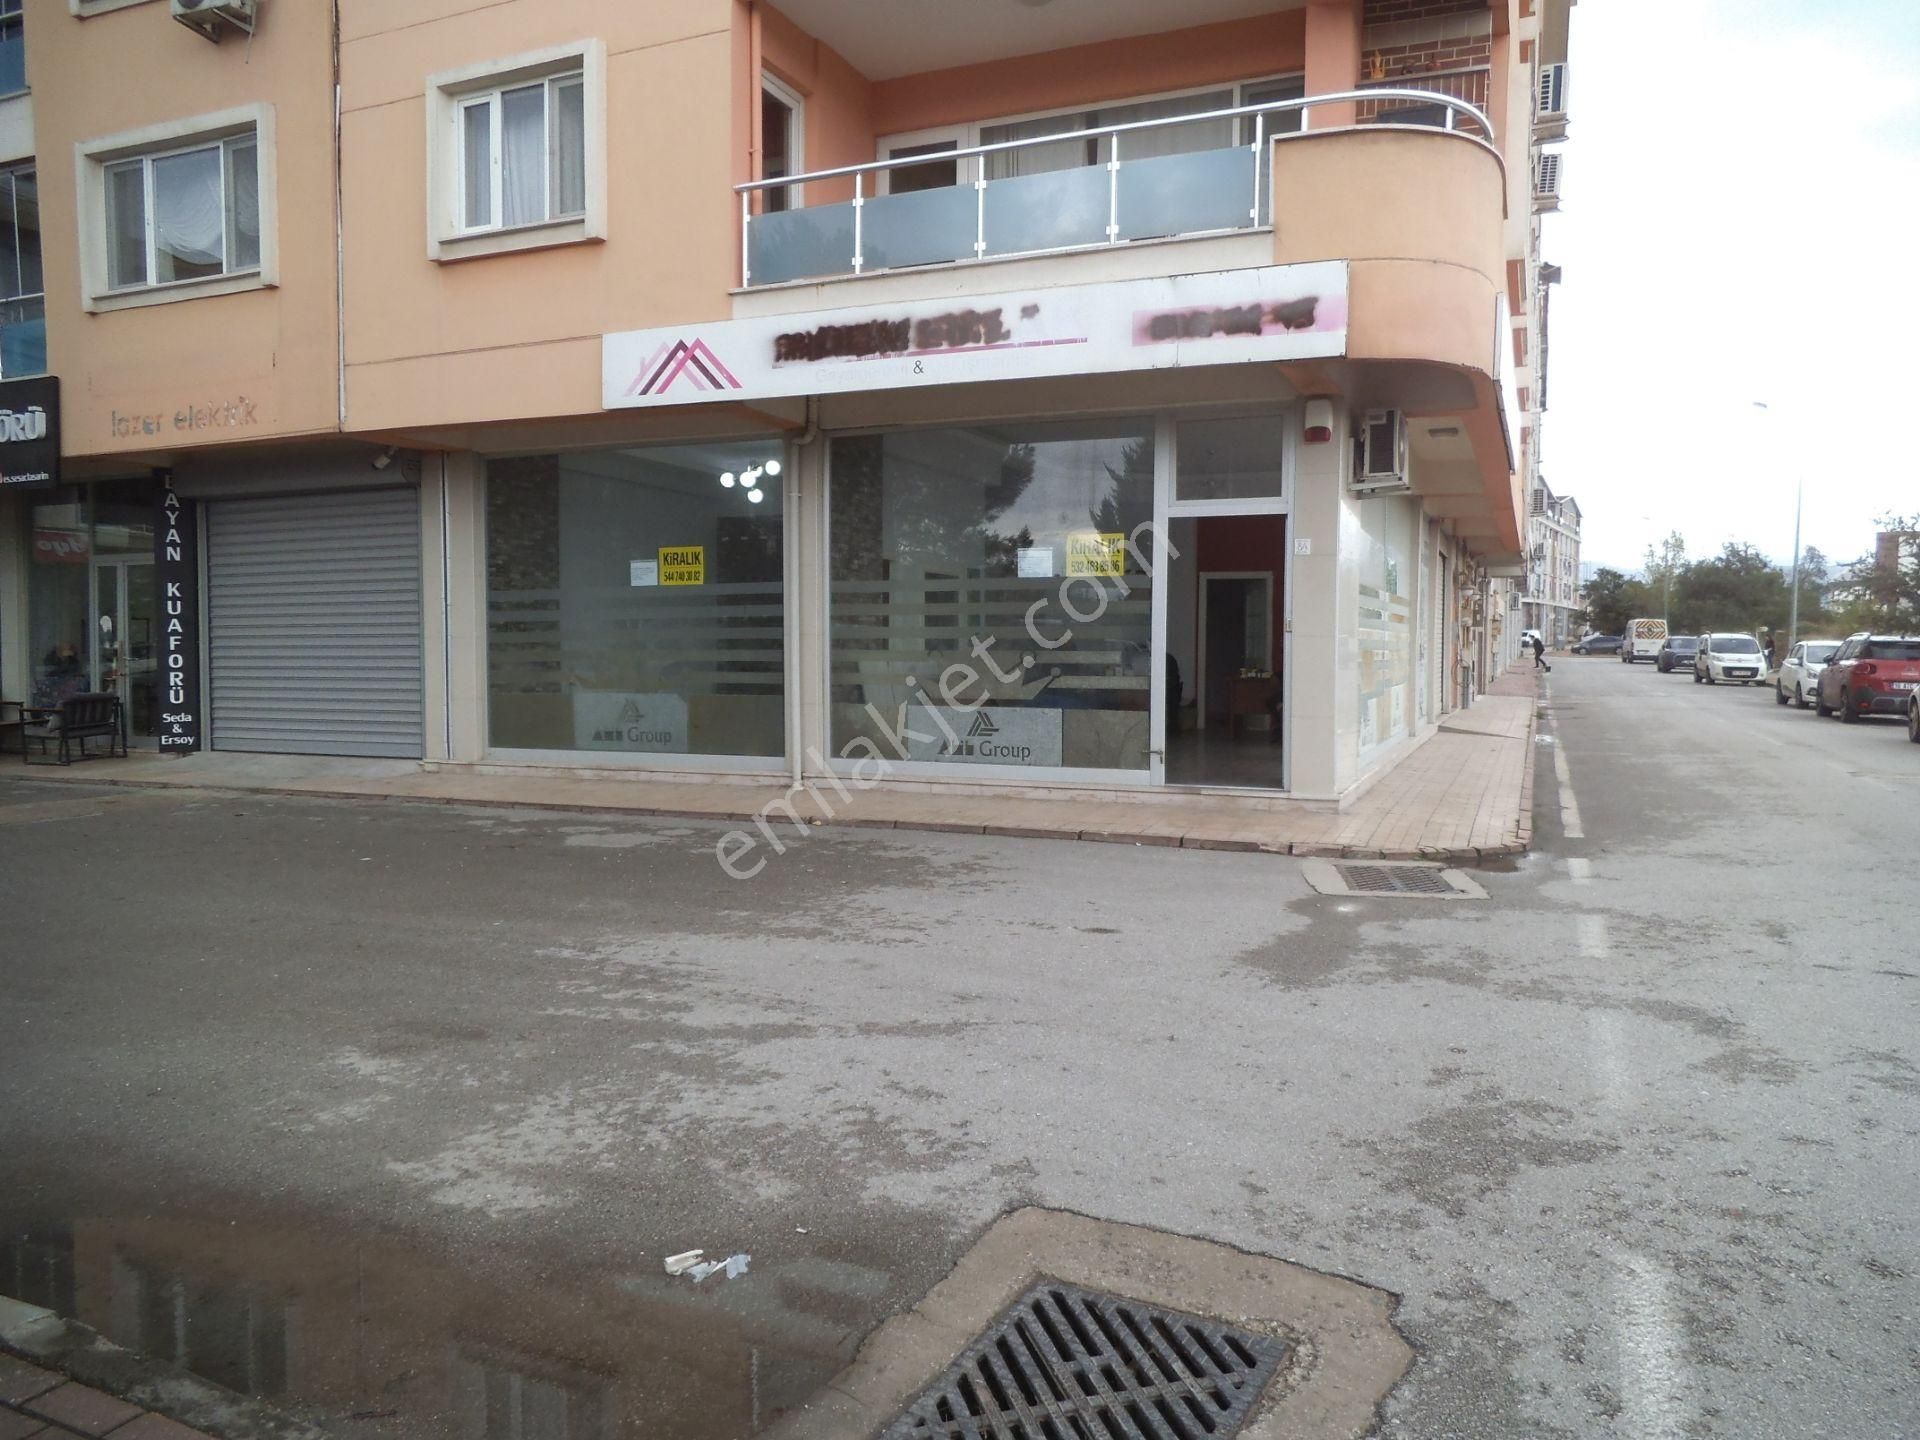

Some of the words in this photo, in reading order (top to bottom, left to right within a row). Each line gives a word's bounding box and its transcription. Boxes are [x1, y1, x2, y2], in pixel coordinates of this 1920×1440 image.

[912, 359, 924, 375] &
[162, 712, 192, 723] Seda
[173, 723, 183, 734] &
[627, 726, 672, 745] Group
[161, 734, 195, 746] Ersoy
[979, 740, 1031, 761] Group
